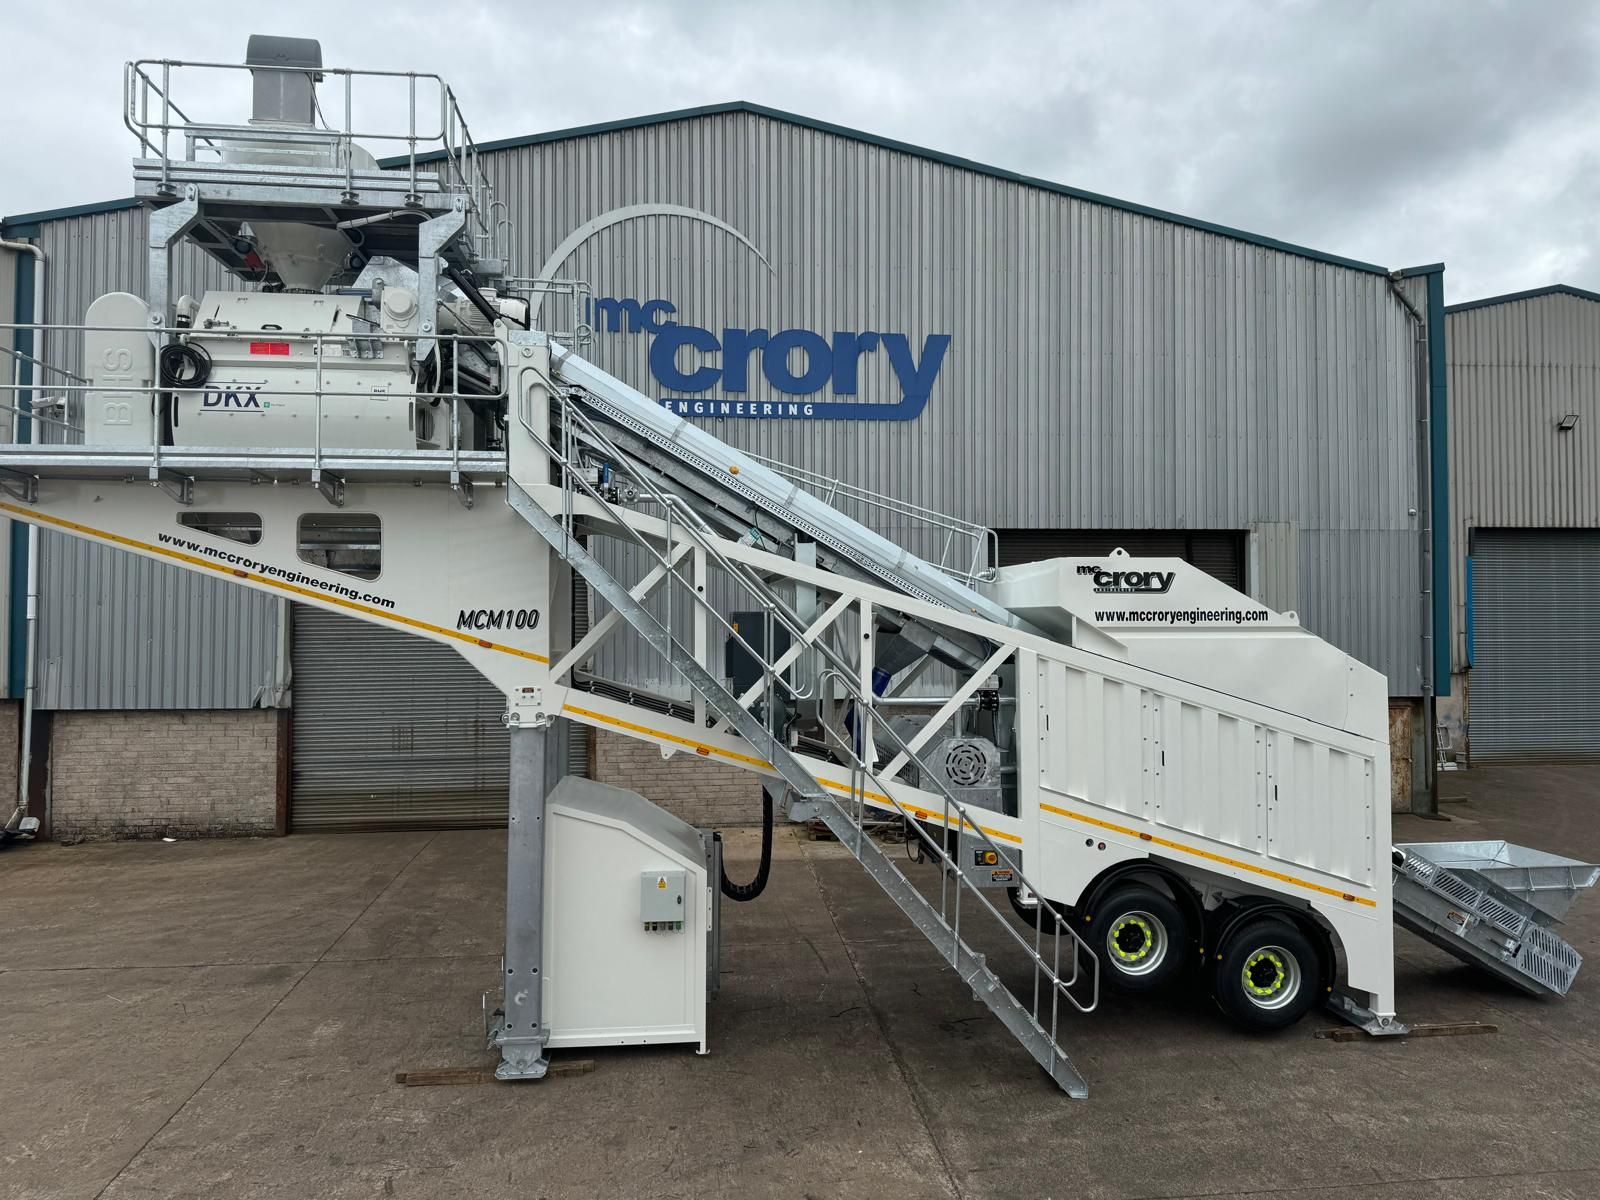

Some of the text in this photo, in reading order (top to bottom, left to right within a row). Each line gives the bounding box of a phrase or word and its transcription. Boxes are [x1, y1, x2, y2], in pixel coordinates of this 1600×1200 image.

[203, 386, 262, 408] DKX
[665, 401, 814, 416] ENGINEERING
[158, 532, 395, 609] www.mccroryengineering.com
[456, 609, 540, 629] MCM100
[1095, 607, 1268, 624] www.mccroryengineering.com
